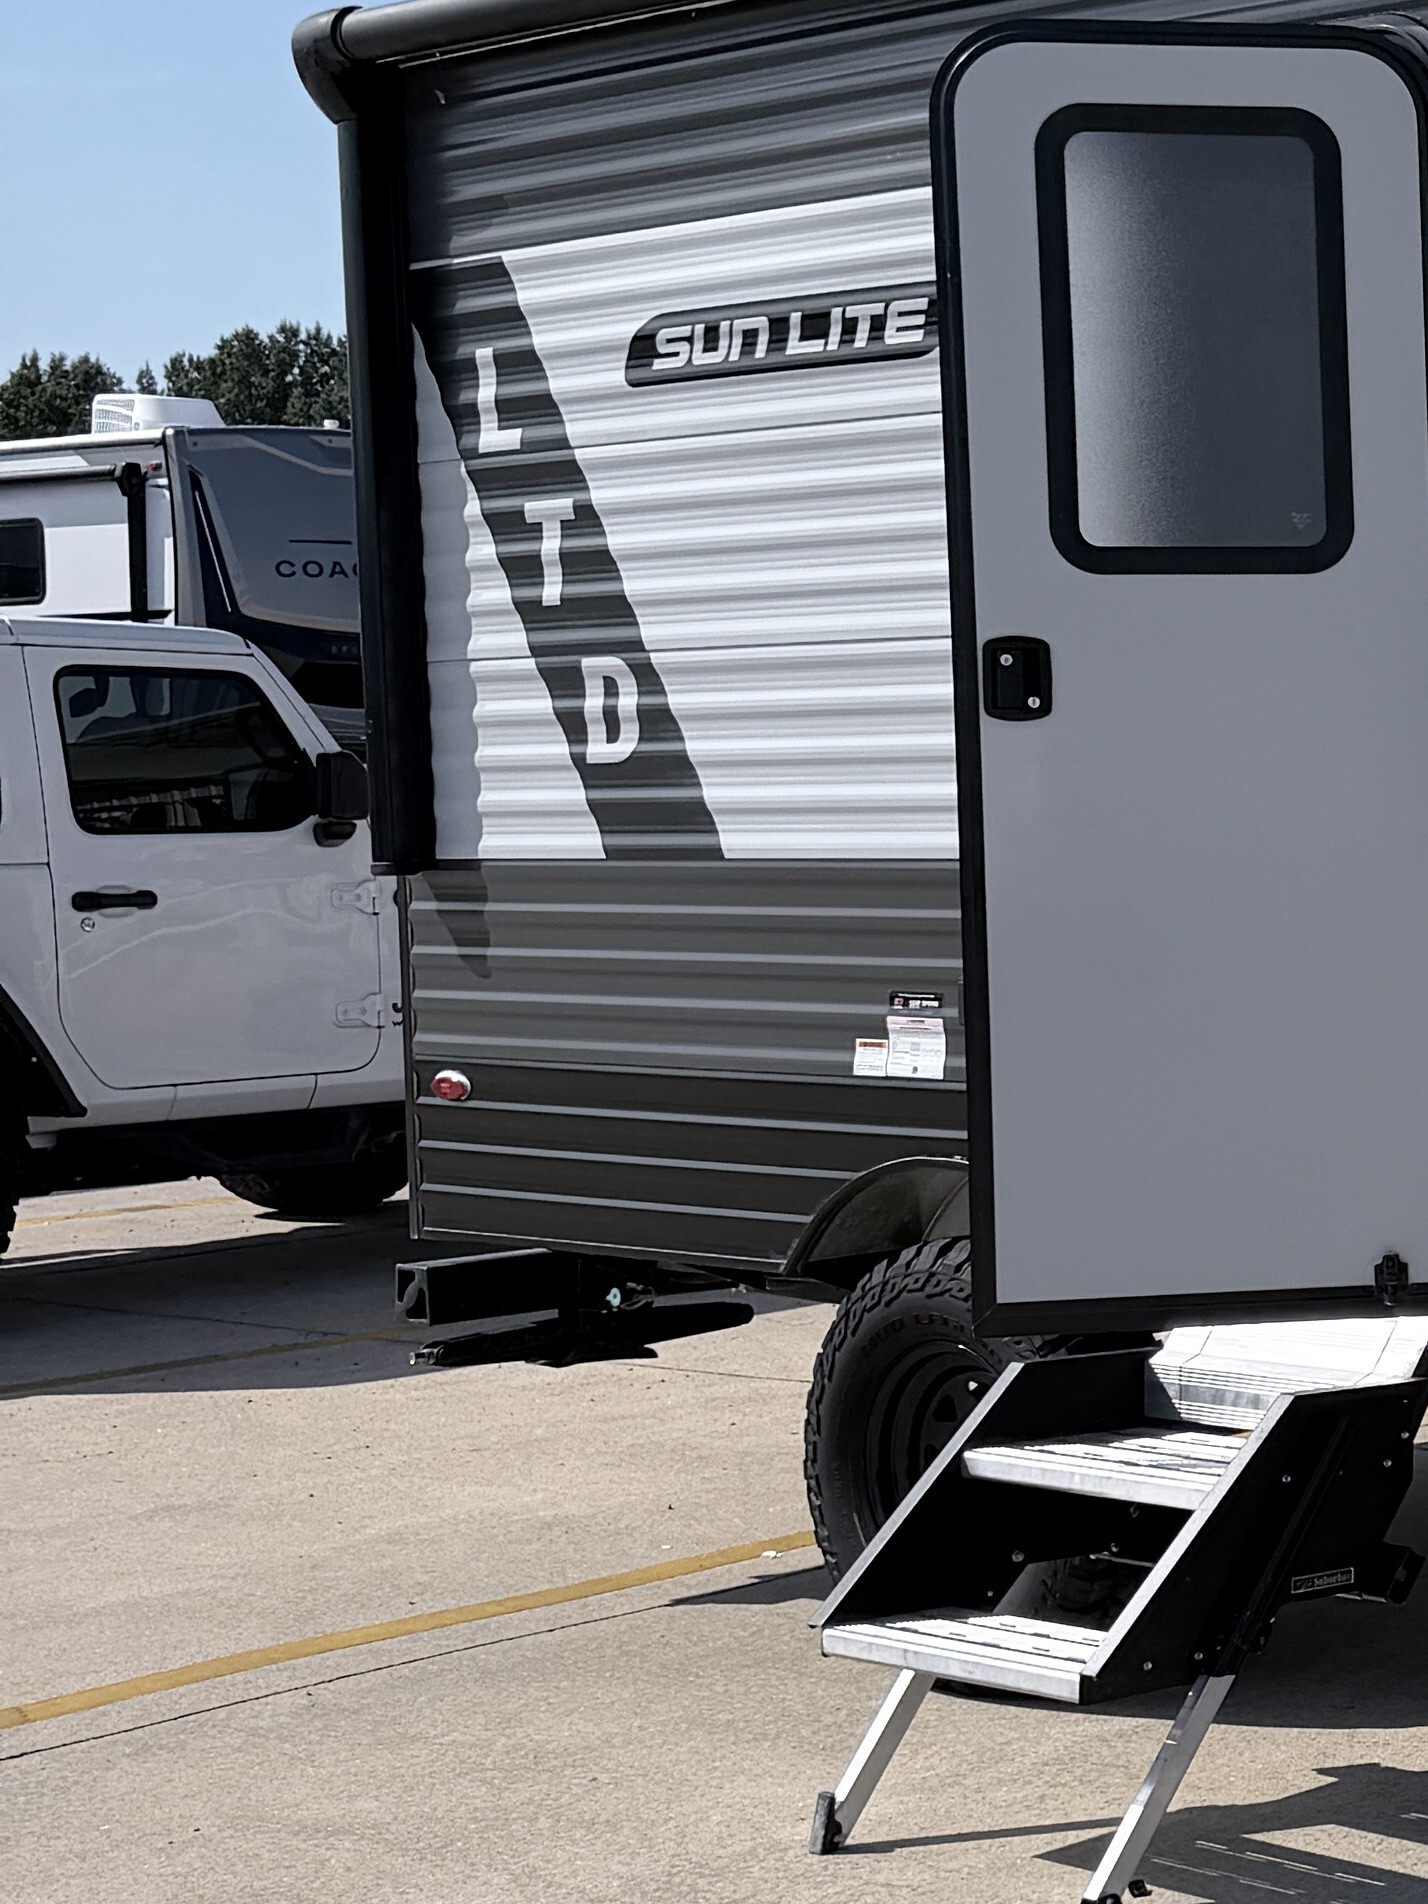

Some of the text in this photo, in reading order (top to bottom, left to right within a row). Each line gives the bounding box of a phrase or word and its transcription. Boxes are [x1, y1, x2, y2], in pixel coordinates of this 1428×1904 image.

[652, 297, 930, 371] SUN LITE
[275, 560, 358, 578] COA
[475, 347, 640, 765] LTD
